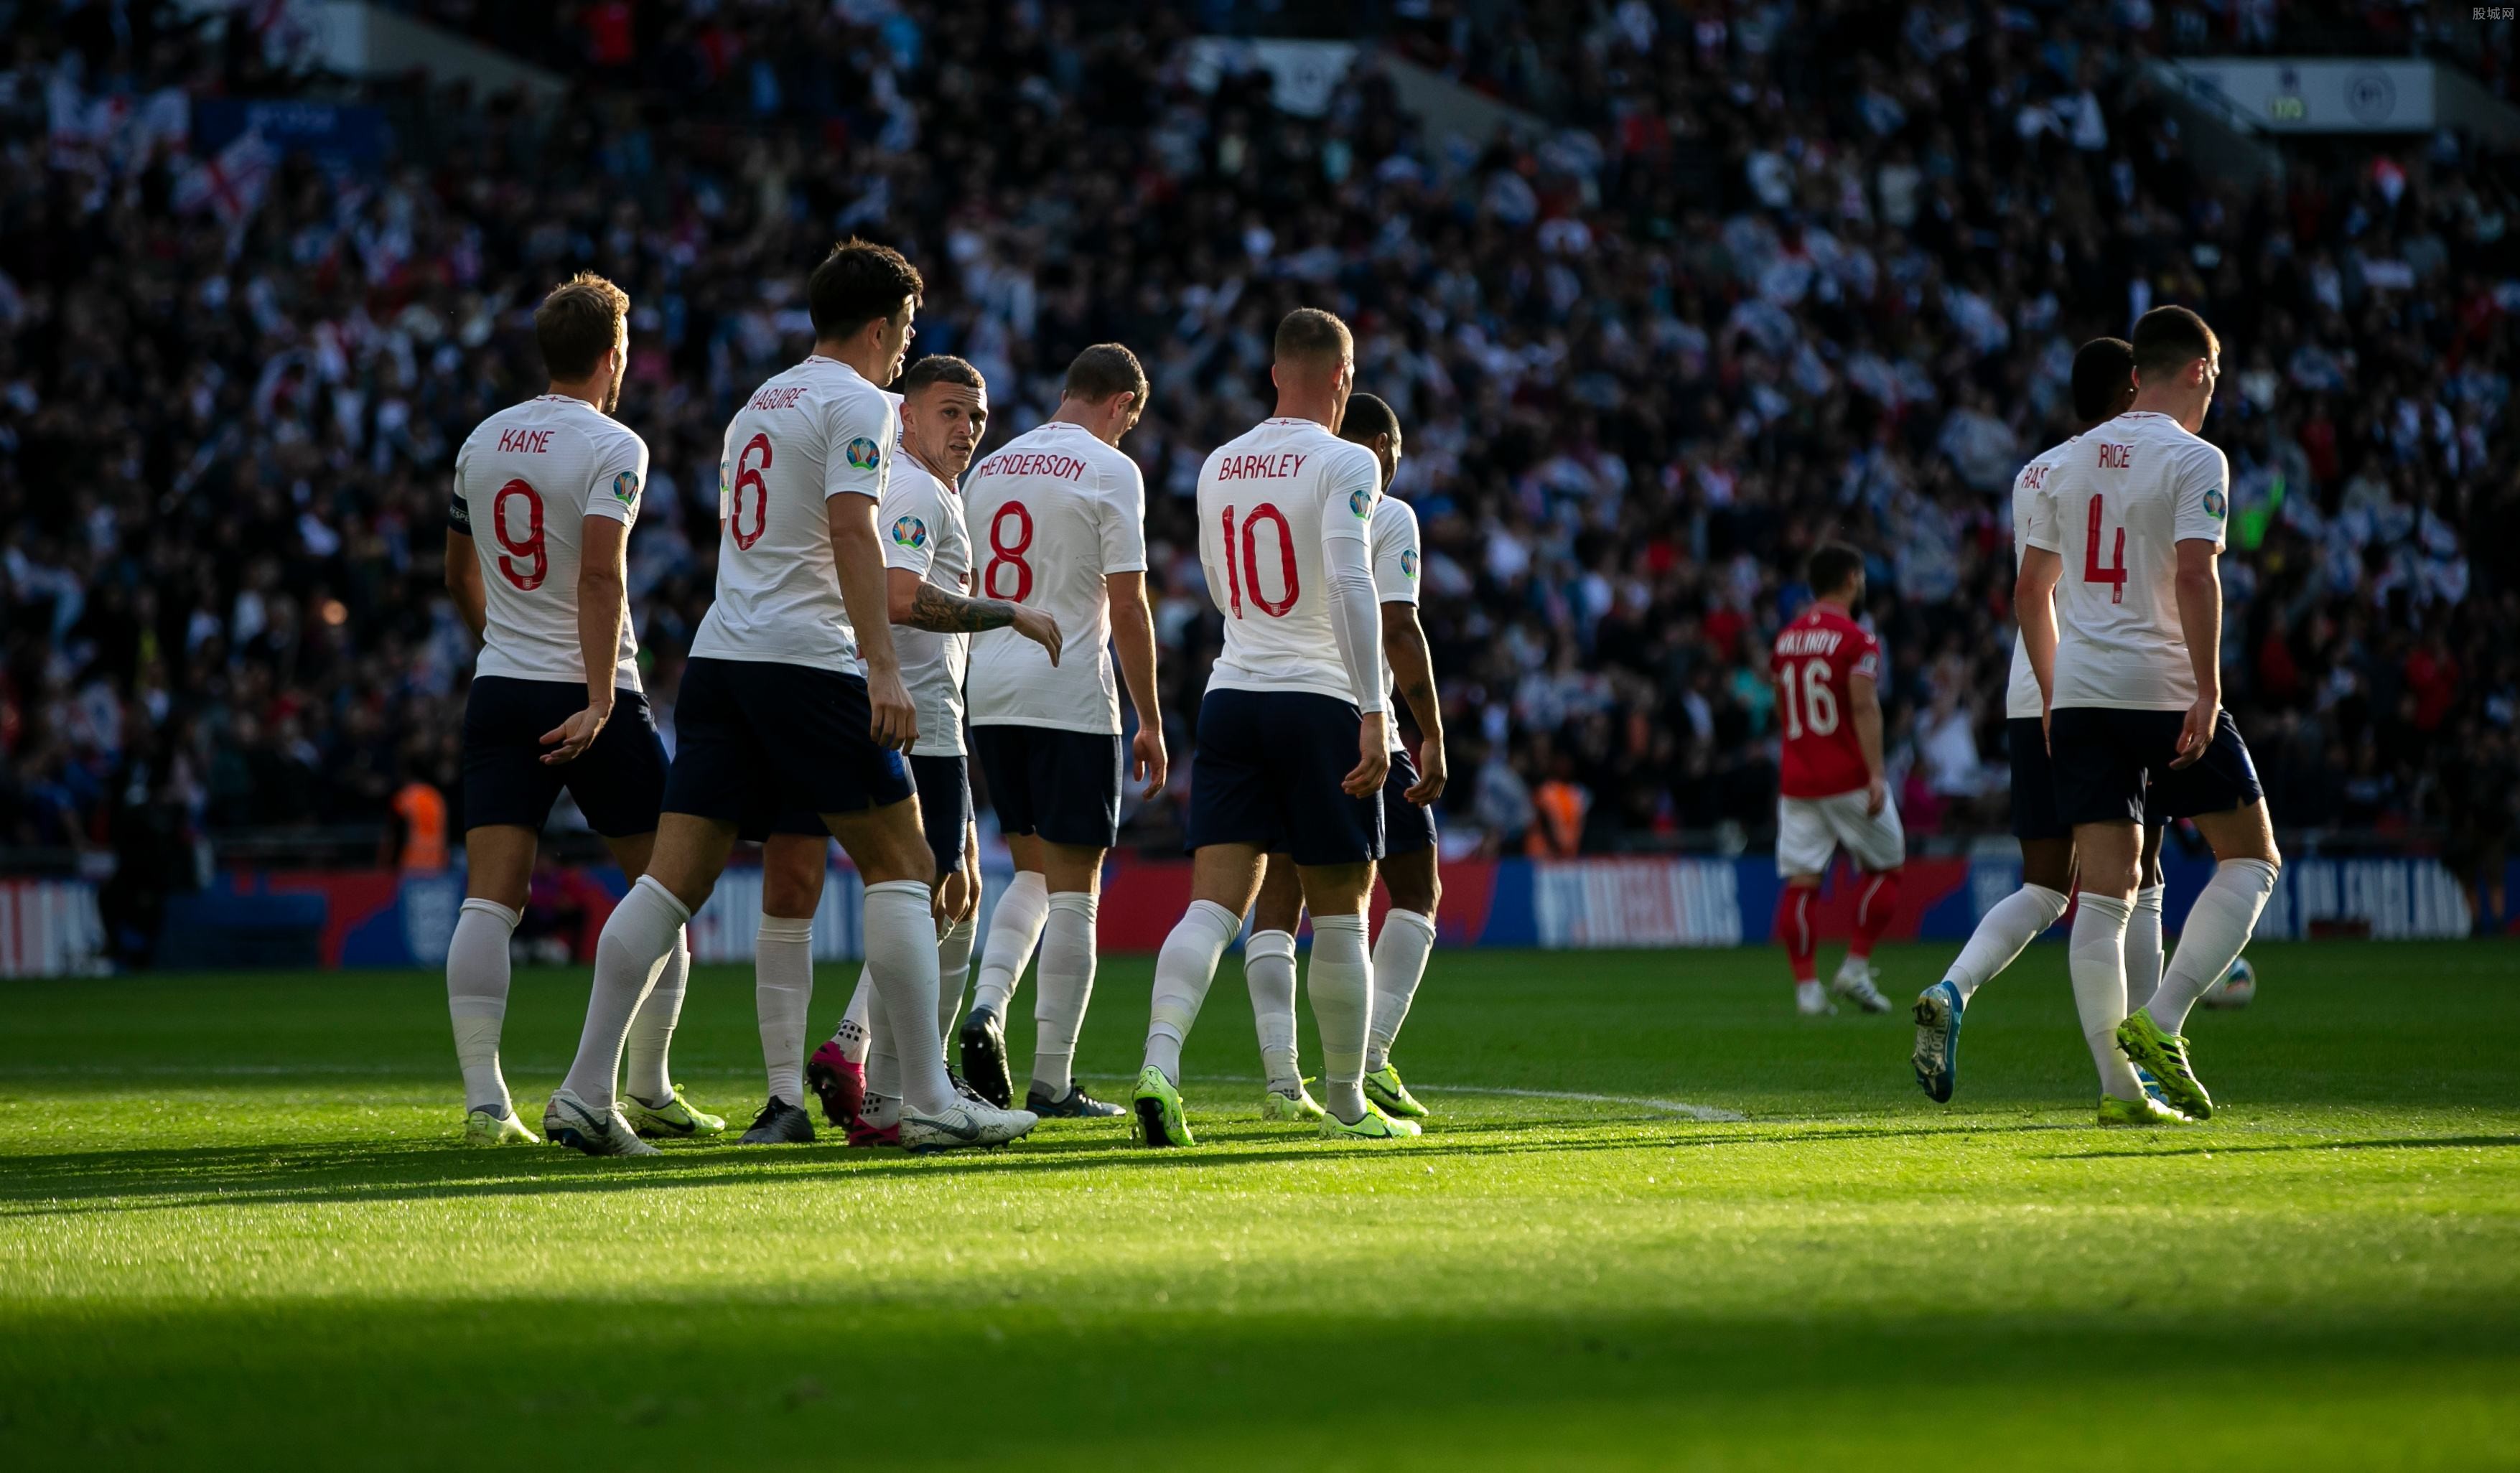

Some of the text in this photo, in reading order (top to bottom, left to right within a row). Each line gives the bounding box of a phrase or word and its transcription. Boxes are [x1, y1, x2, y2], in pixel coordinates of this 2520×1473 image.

[498, 429, 555, 453] KANE
[745, 388, 808, 413] MAGUIRE
[731, 433, 773, 551] 6
[979, 454, 1087, 482] HENDERSON
[1218, 453, 1307, 481] BARKLEY
[2099, 444, 2134, 468] RICE
[494, 478, 549, 591] 9
[984, 500, 1034, 604] 8
[1221, 502, 1300, 621] 10
[2083, 493, 2128, 604] 4
[1781, 657, 1839, 742] 16
